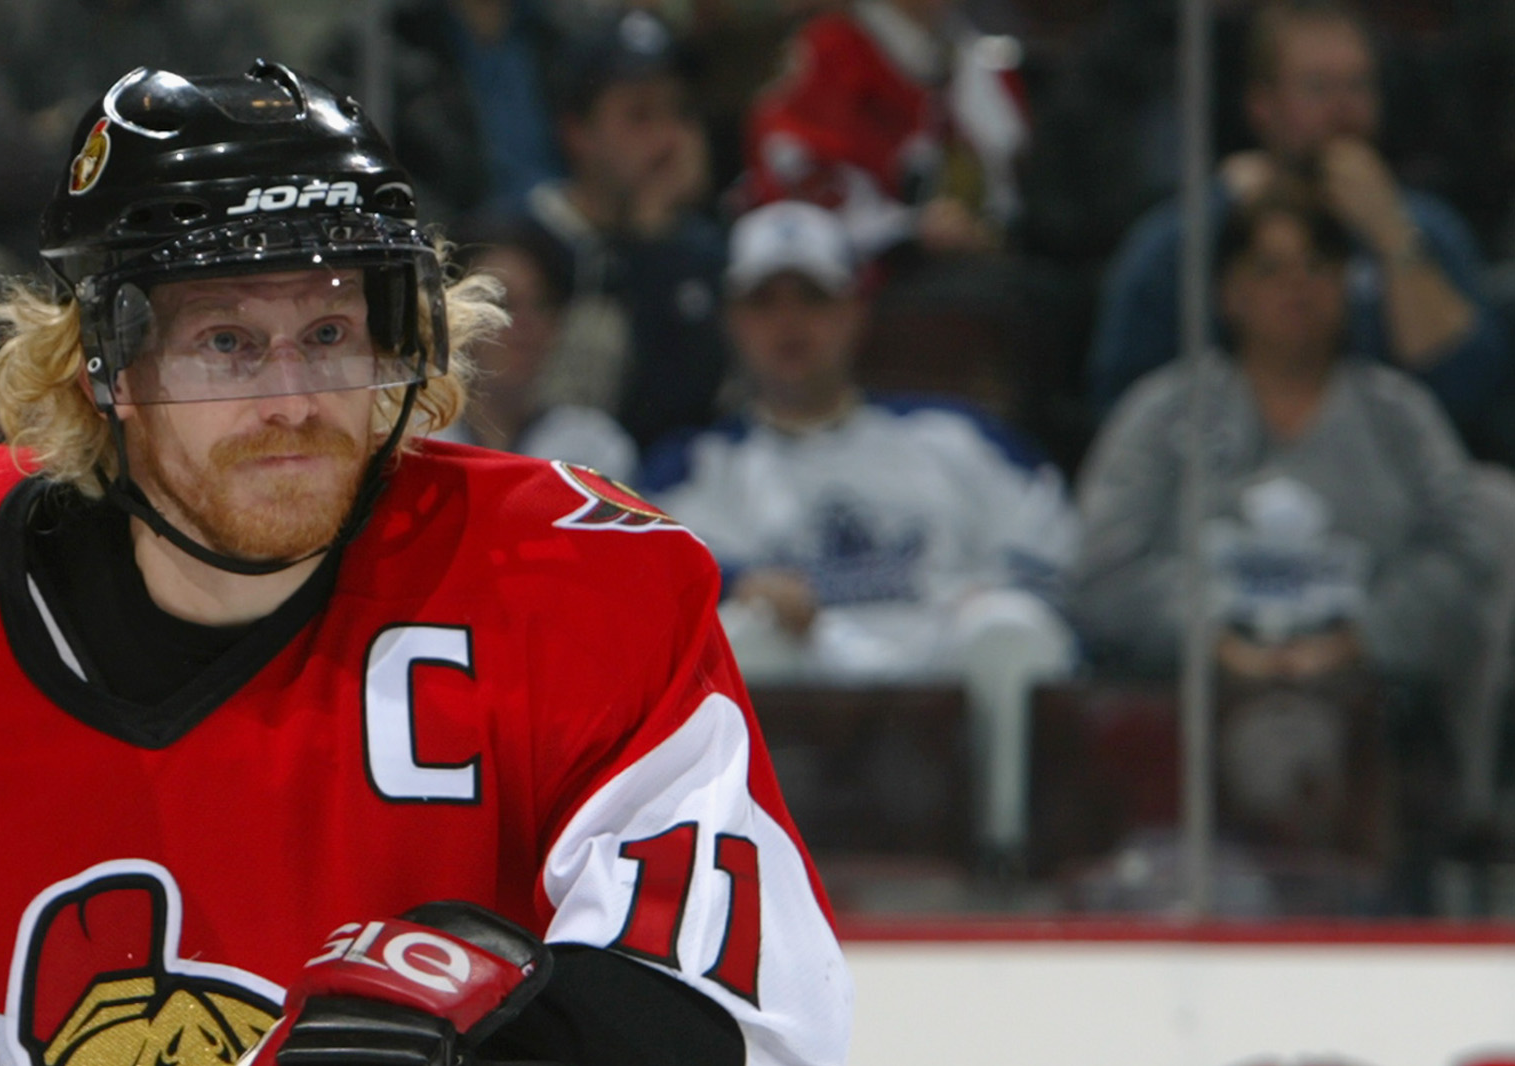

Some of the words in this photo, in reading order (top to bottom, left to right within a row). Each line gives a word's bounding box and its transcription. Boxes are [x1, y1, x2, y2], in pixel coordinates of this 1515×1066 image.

[226, 181, 358, 215] JOFA
[361, 623, 482, 804] C
[606, 821, 761, 1012] 11
